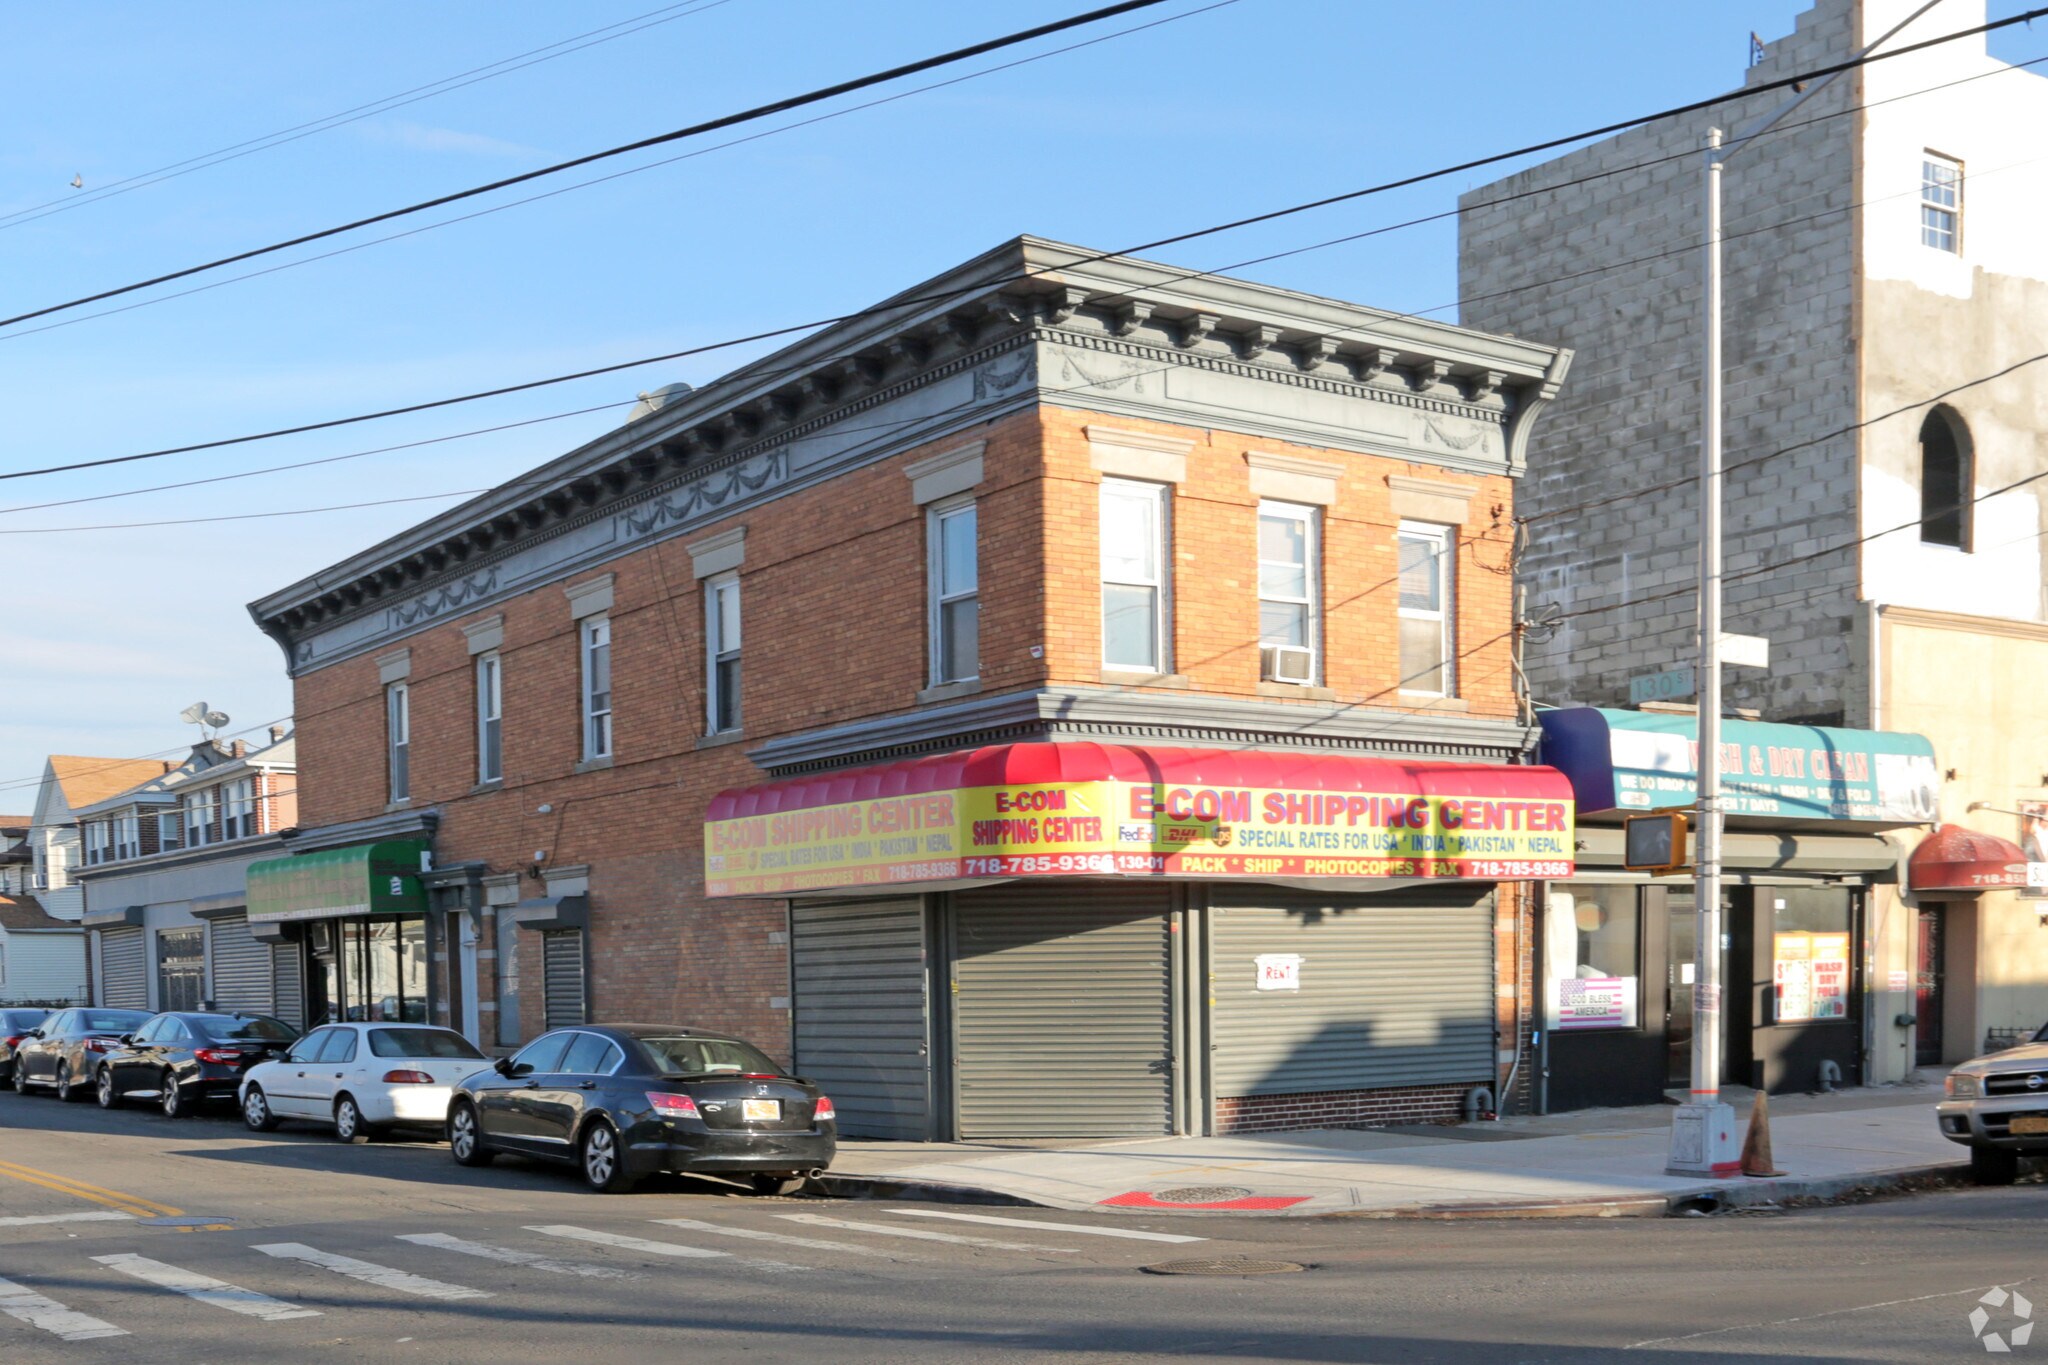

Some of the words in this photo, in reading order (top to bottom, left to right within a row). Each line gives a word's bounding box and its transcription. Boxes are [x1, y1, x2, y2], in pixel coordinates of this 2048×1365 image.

[1636, 675, 1672, 698] 130
[1749, 745, 1764, 776] &
[1768, 746, 1805, 778] DRY
[1811, 750, 1868, 782] CLEAN
[1619, 775, 1637, 788] WE
[1640, 776, 1655, 790] DO
[1658, 777, 1685, 791] DROP
[1780, 784, 1809, 798] WASH
[1849, 788, 1871, 801] FOLD
[995, 790, 1067, 813] E-COM
[1130, 786, 1251, 822] E-COM
[1262, 792, 1429, 829] SHIPPING
[1439, 799, 1566, 832] CENTER
[1740, 798, 1747, 811] 7
[1750, 798, 1779, 812] DAYS
[712, 817, 767, 852] E-COM
[771, 804, 862, 846] SHIPPING
[868, 794, 954, 834] CENTER
[972, 818, 1038, 847] SHIPPING
[1043, 817, 1103, 843] CENTER
[1119, 826, 1154, 841] FedEx
[1168, 828, 1197, 841] DHL
[1240, 829, 1294, 847] SPECIAL
[1300, 832, 1339, 849] RATES
[1344, 833, 1368, 850] FOR
[1373, 834, 1398, 850] USA
[1412, 835, 1445, 851] INDIA
[1459, 836, 1515, 852] PAKISTAN
[1528, 837, 1562, 852] NEPAL
[926, 833, 953, 852] NEPAL
[889, 862, 957, 880] 718-785-9366
[965, 854, 1116, 874] 718-785-9366
[1118, 856, 1164, 869] 130-01
[1182, 857, 1227, 873] PACK
[1244, 858, 1283, 873] SHIP
[1305, 859, 1414, 875] PHOTOCOPIES
[1430, 861, 1457, 875] FAX
[1471, 861, 1568, 876] 718-785-9366
[1814, 962, 1842, 972] WASH
[1819, 974, 1837, 985] DRY
[1571, 994, 1586, 1004] GOD
[1589, 994, 1611, 1003] BLESS
[1817, 986, 1839, 997] FOLD
[1575, 1007, 1608, 1015] AMERICA
